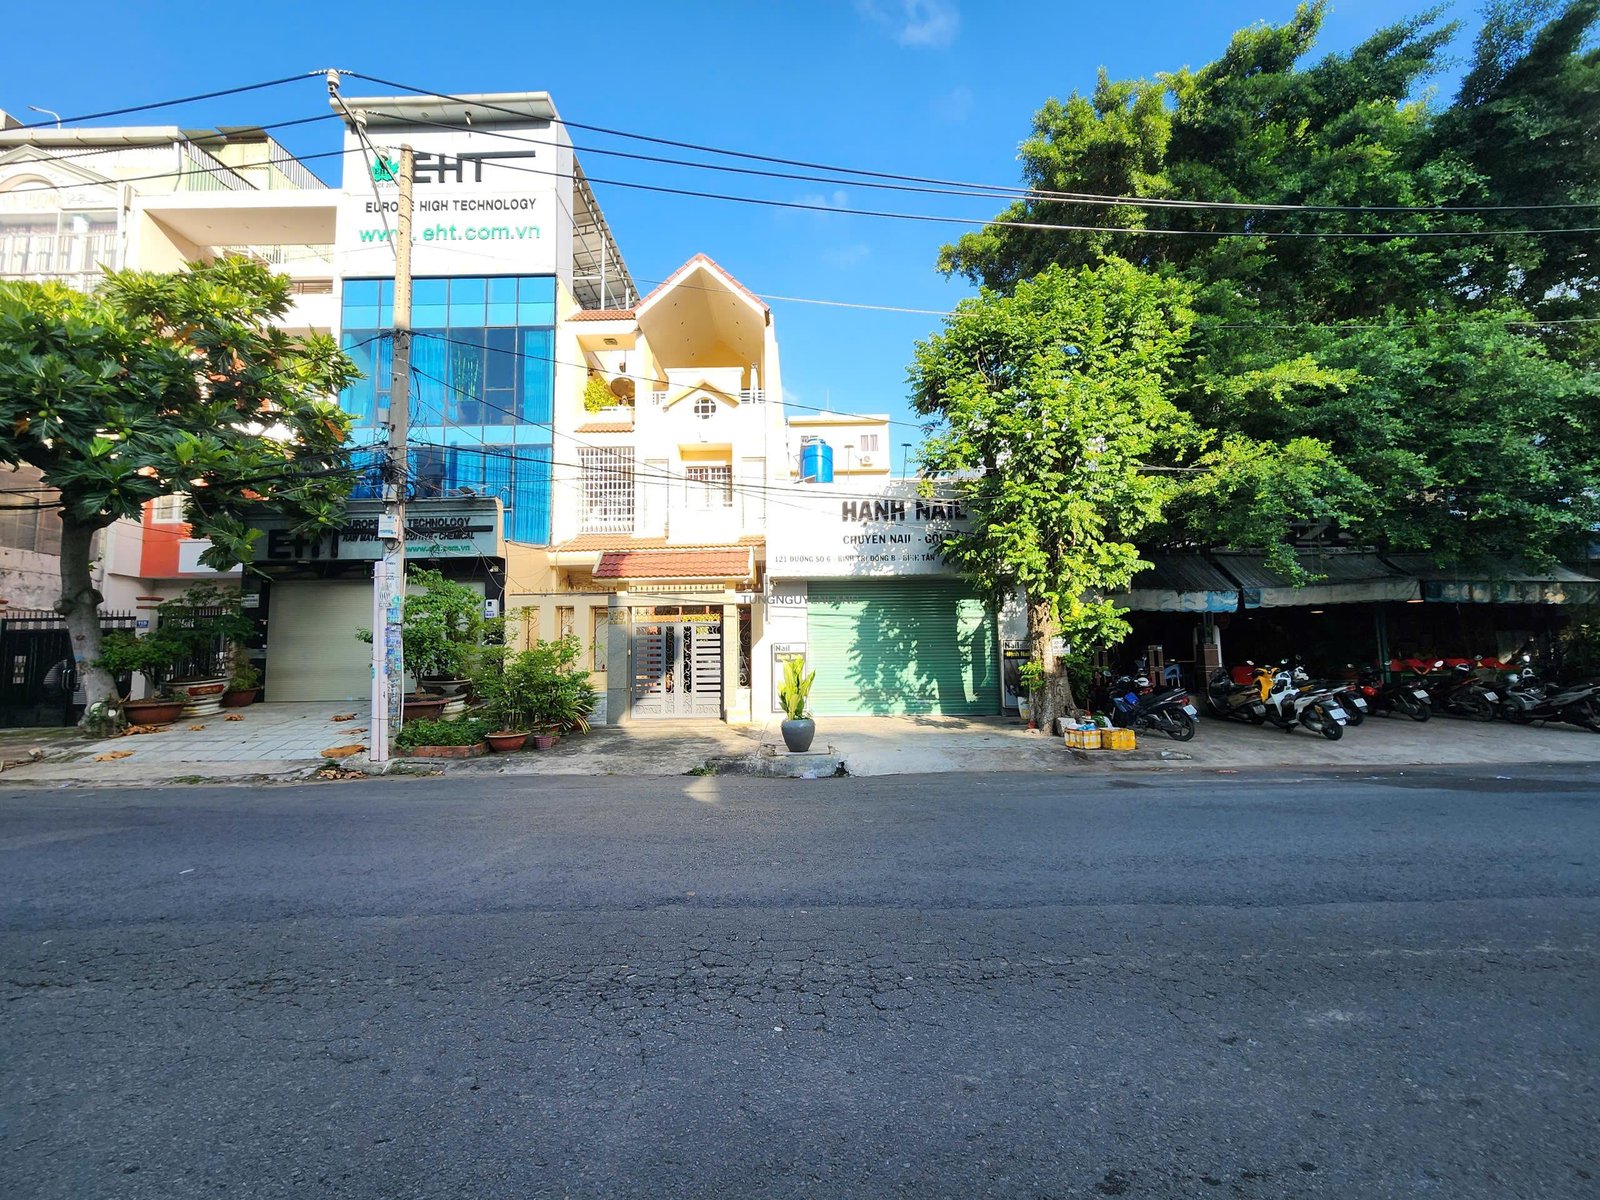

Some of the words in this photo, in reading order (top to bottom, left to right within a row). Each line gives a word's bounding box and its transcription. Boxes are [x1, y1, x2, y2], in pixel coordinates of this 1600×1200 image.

[413, 150, 535, 183] EHT
[365, 201, 414, 213] EURO
[419, 200, 449, 212] HIGH
[452, 198, 536, 211] TECHNOLOGY
[915, 499, 968, 521] NAIL
[346, 519, 379, 530] UROPE
[407, 517, 471, 528] TECHNOLOGY
[438, 530, 475, 540] CHEMICAL
[1004, 641, 1020, 649] Nail
